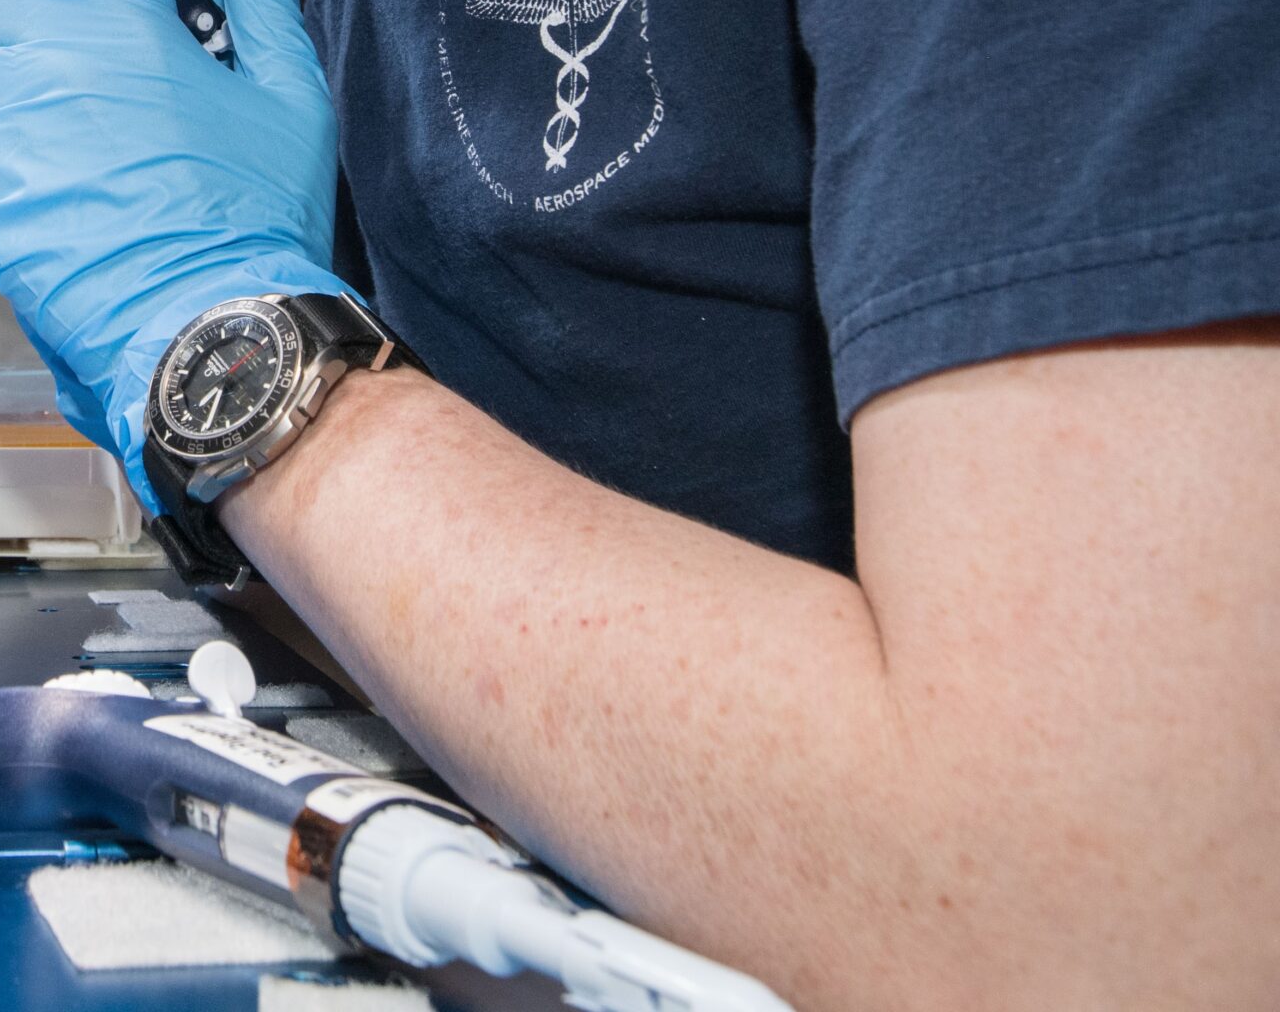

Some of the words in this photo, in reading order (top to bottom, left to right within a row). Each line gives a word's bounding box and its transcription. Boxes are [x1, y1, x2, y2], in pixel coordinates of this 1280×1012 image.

[438, 37, 472, 145] MEDICINE
[466, 142, 513, 205] BRANCH
[535, 150, 631, 213] AEROSPACE
[633, 51, 665, 154] MEDICAL
[285, 331, 297, 350] 35
[280, 369, 295, 389] 40
[187, 443, 205, 454] 55
[222, 432, 243, 449] 50
